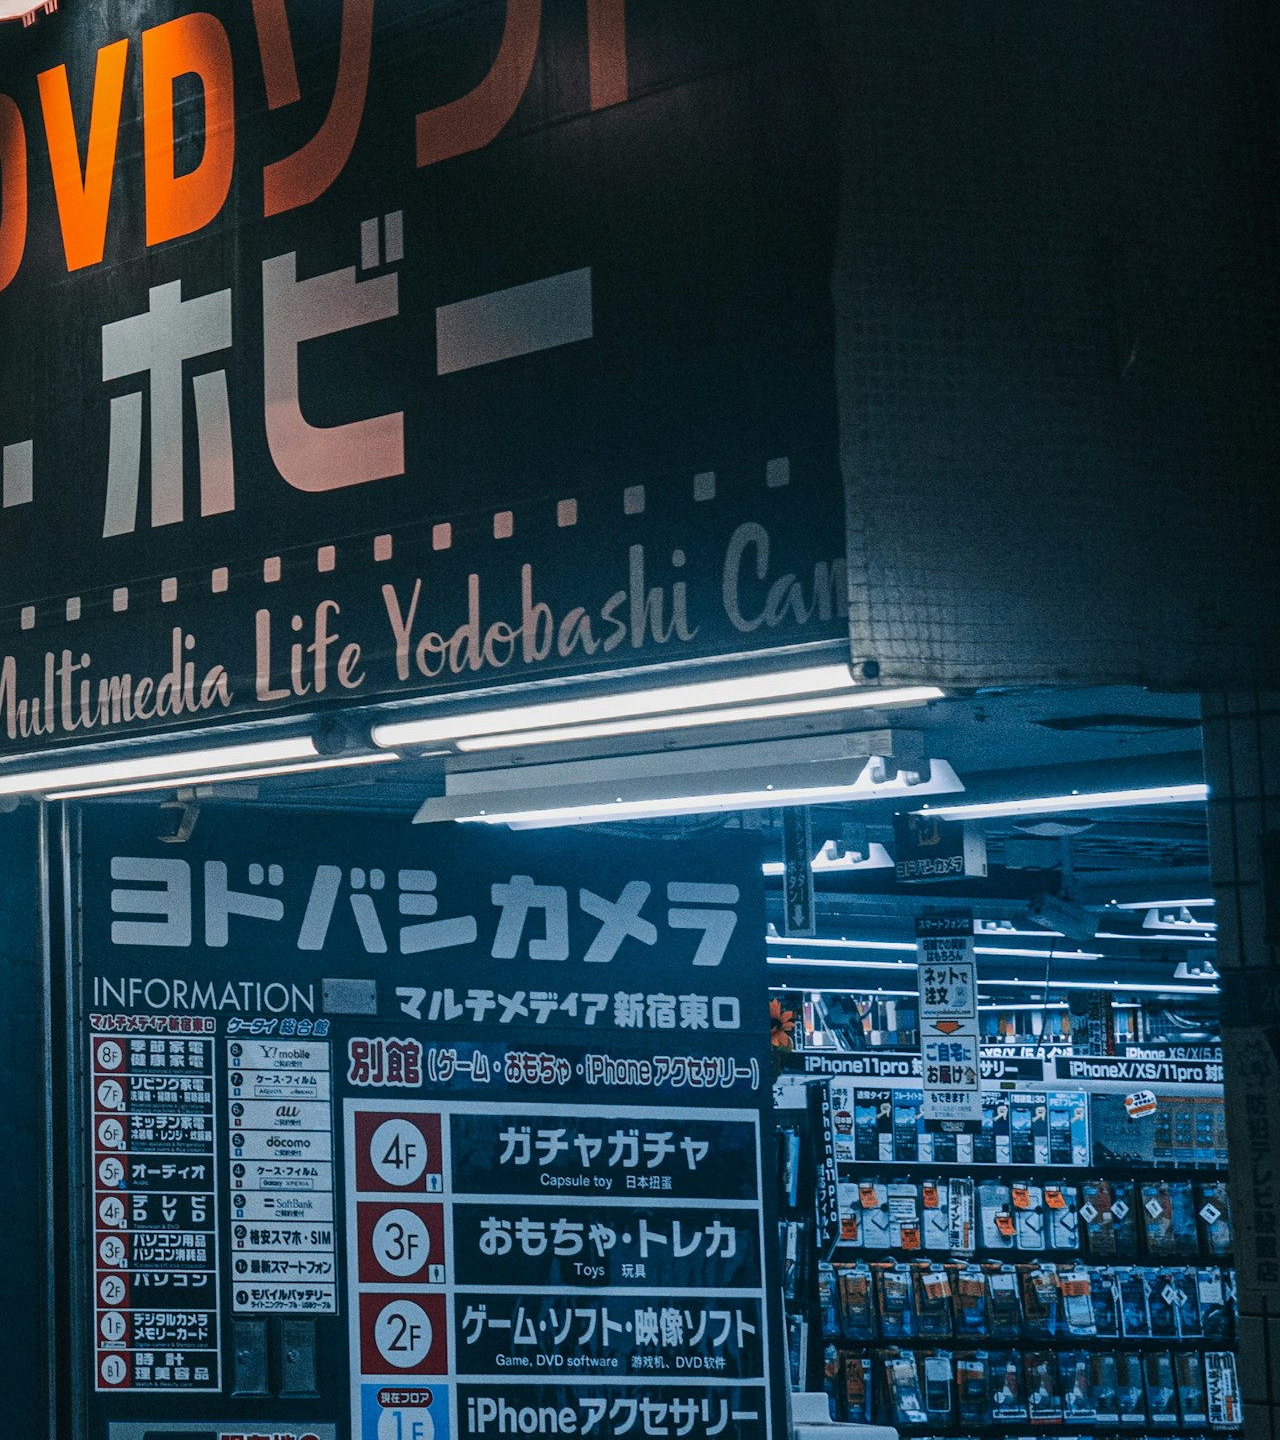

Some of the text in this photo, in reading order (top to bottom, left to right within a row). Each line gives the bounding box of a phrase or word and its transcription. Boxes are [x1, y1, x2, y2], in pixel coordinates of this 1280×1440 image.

[255, 607, 368, 704] Life
[380, 546, 702, 683] Yodobashi
[895, 855, 964, 877] ヨドバシカメラ
[109, 855, 741, 968] ヨドバシカメラ
[926, 950, 964, 962] はもちろん
[924, 967, 968, 986] ネットで
[93, 976, 315, 1014] INFORMATION
[924, 986, 949, 1006] 注文
[395, 985, 741, 1031] マルチメディア新宿東口
[89, 1013, 217, 1034] マルチメディア新宿東口
[226, 1017, 331, 1036] ケータイ 総合館
[101, 1046, 119, 1064] 8F
[926, 1041, 972, 1063] ご自宅に
[347, 1036, 423, 1089] 別館
[804, 1055, 910, 1077] iPhone11pro
[255, 1074, 318, 1085] ケース・フィルム
[926, 1065, 964, 1085] お届け
[1068, 1061, 1204, 1082] iPhoneX/XS/11pro
[130, 1077, 205, 1092] リビング家電
[102, 1085, 119, 1102] 7F
[275, 1104, 301, 1117] au
[131, 1115, 206, 1130] キッチン家電
[103, 1124, 119, 1141] 6F
[386, 1134, 421, 1171] 4F
[499, 1126, 710, 1170] ガチャガチャ
[103, 1163, 119, 1181] 5F
[131, 1163, 206, 1180] オーディオ
[256, 1166, 318, 1177] ケース・フィルム
[539, 1173, 613, 1190] Capsule toy
[132, 1194, 207, 1209] テレビ
[275, 1197, 313, 1209] SoftBank
[104, 1202, 120, 1219] 4F
[132, 1209, 206, 1222] DVD
[133, 1233, 207, 1248] パソコン用品
[249, 1230, 332, 1246] 格安スマホ・SIM
[385, 1223, 420, 1261] 3F
[478, 1216, 737, 1258] おもちゃ・トレカ
[104, 1242, 121, 1259] 3F
[250, 1260, 332, 1274] 最新スマートフォン
[573, 1263, 606, 1279] Toys
[621, 1263, 647, 1279] 玩具
[133, 1273, 208, 1288] パソコン
[105, 1281, 121, 1298] 2F
[251, 1289, 333, 1301] モバイルバッテリー
[107, 1317, 122, 1335] 1F
[133, 1313, 209, 1326] デジタルカメラ
[462, 1304, 756, 1348] ゲーム・ソフト・映像ソフト
[134, 1327, 209, 1341] メモリーカード
[385, 1314, 422, 1351] 2F
[135, 1352, 185, 1366] 時計
[495, 1353, 619, 1368] Game, DVD software
[135, 1367, 210, 1381] 理美容品
[379, 1391, 430, 1404] 現在フロア
[467, 1397, 759, 1436] iPhoneアクセサリー
